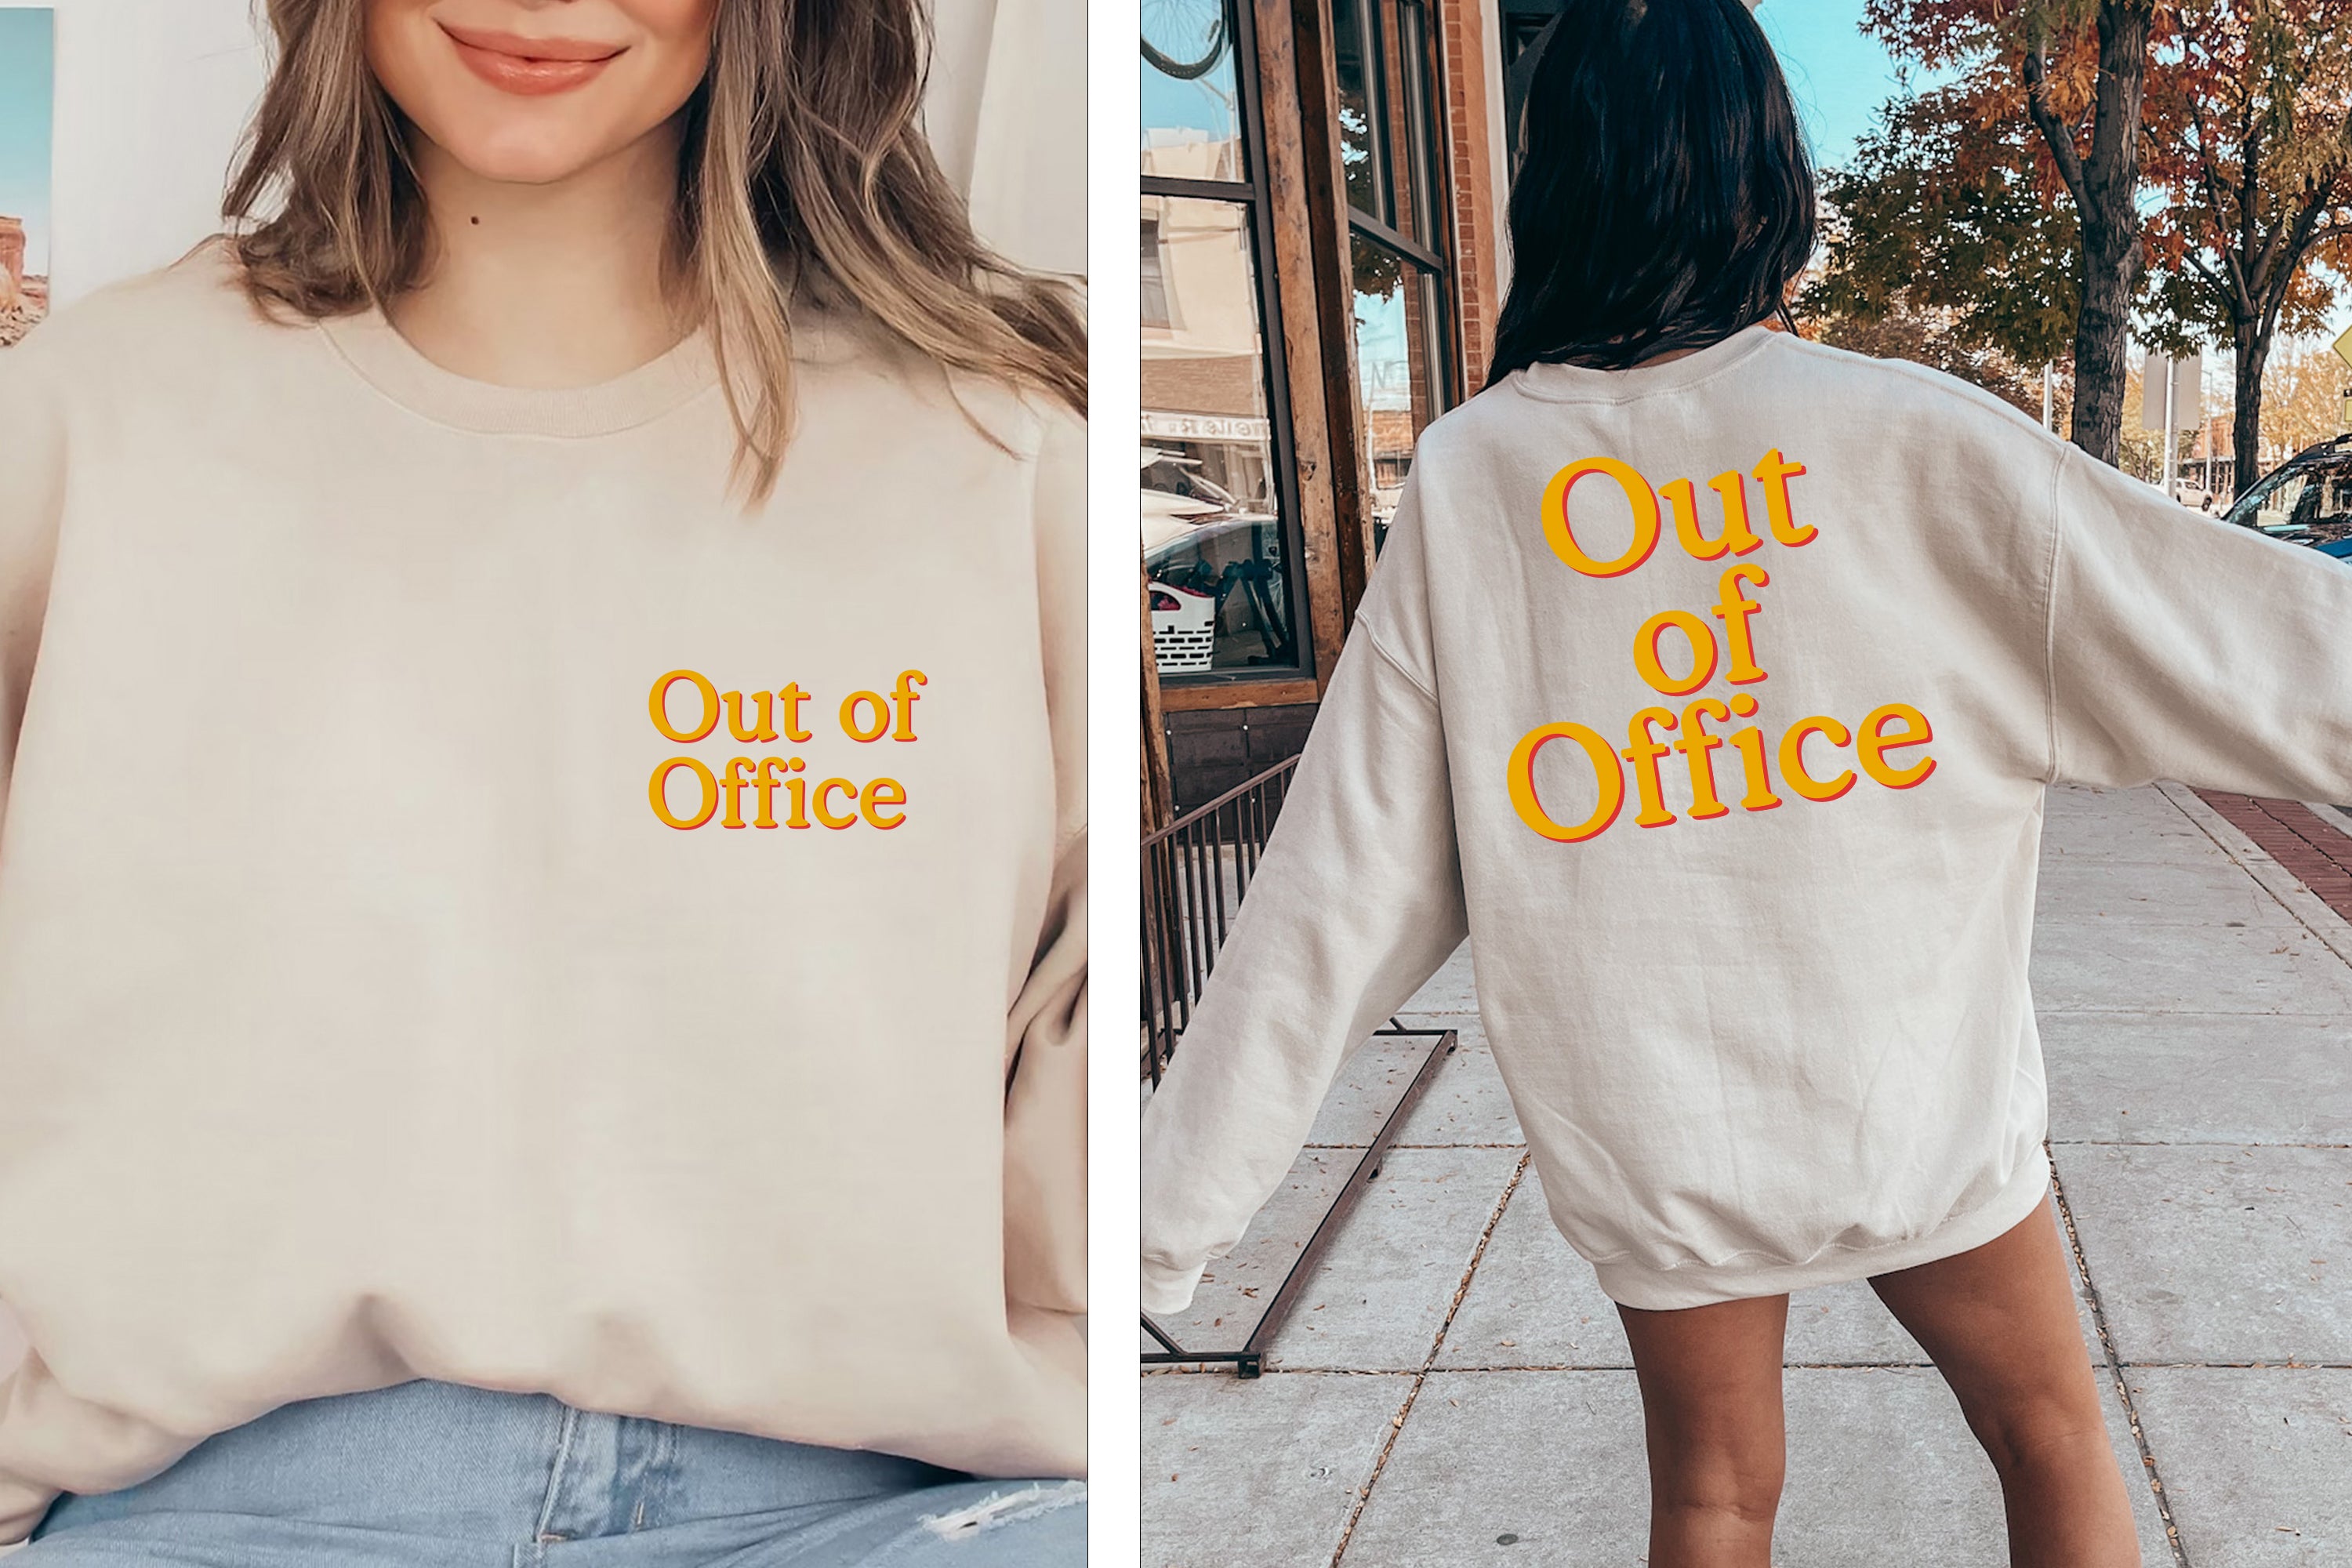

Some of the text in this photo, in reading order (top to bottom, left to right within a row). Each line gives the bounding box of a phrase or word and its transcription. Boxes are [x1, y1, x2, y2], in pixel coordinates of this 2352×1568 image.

[1541, 448, 1818, 578] Out
[1634, 564, 1769, 696] of
[649, 670, 927, 743] Out of
[1507, 693, 1936, 843] Office
[649, 757, 906, 829] Office
